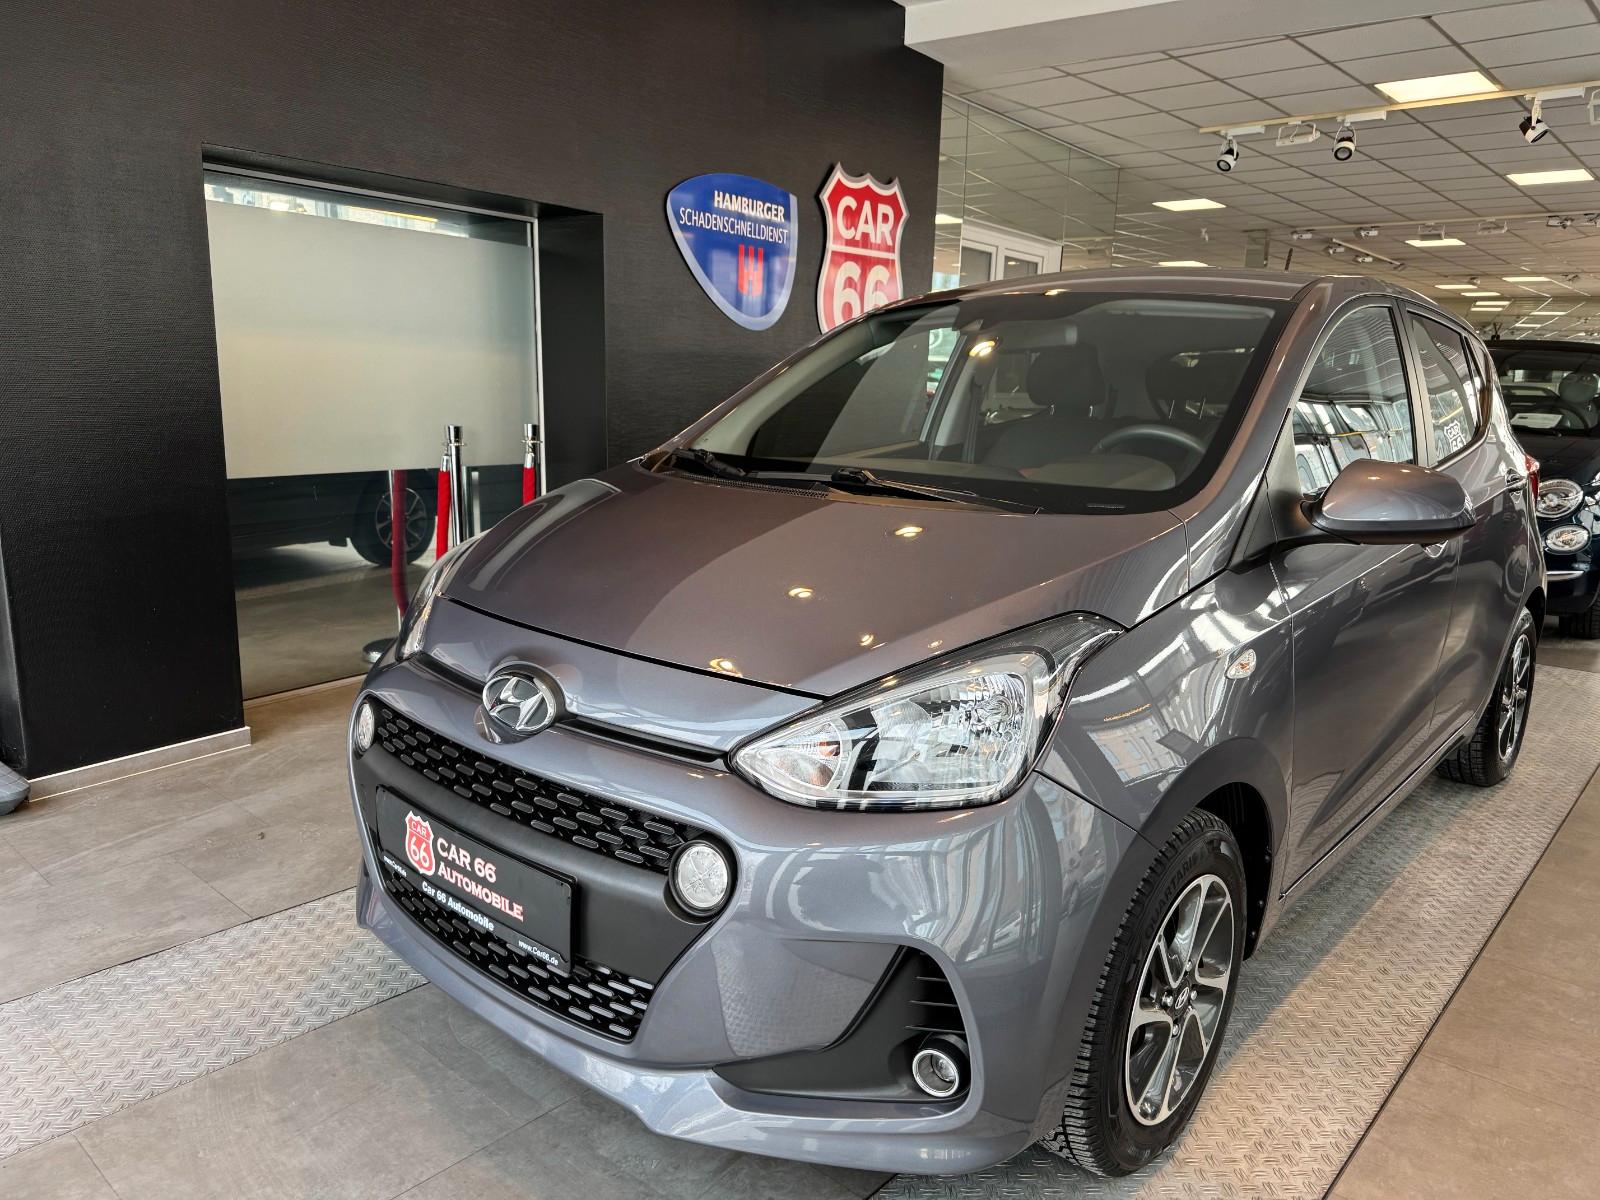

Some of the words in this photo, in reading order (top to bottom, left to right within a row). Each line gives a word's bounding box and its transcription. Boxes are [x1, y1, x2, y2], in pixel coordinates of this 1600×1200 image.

[679, 207, 789, 245] SCHADENSCHNELLDIENST
[713, 190, 785, 223] HAMBURGER
[836, 195, 895, 246] CAR
[833, 260, 890, 328] 66
[410, 835, 430, 868] 66
[411, 821, 427, 838] CAR
[437, 837, 472, 871] CAR
[473, 857, 497, 884] 66
[422, 880, 436, 897] Car
[436, 890, 447, 904] 66
[447, 897, 495, 932] Automobile
[437, 861, 524, 922] AUTOMOBILE
